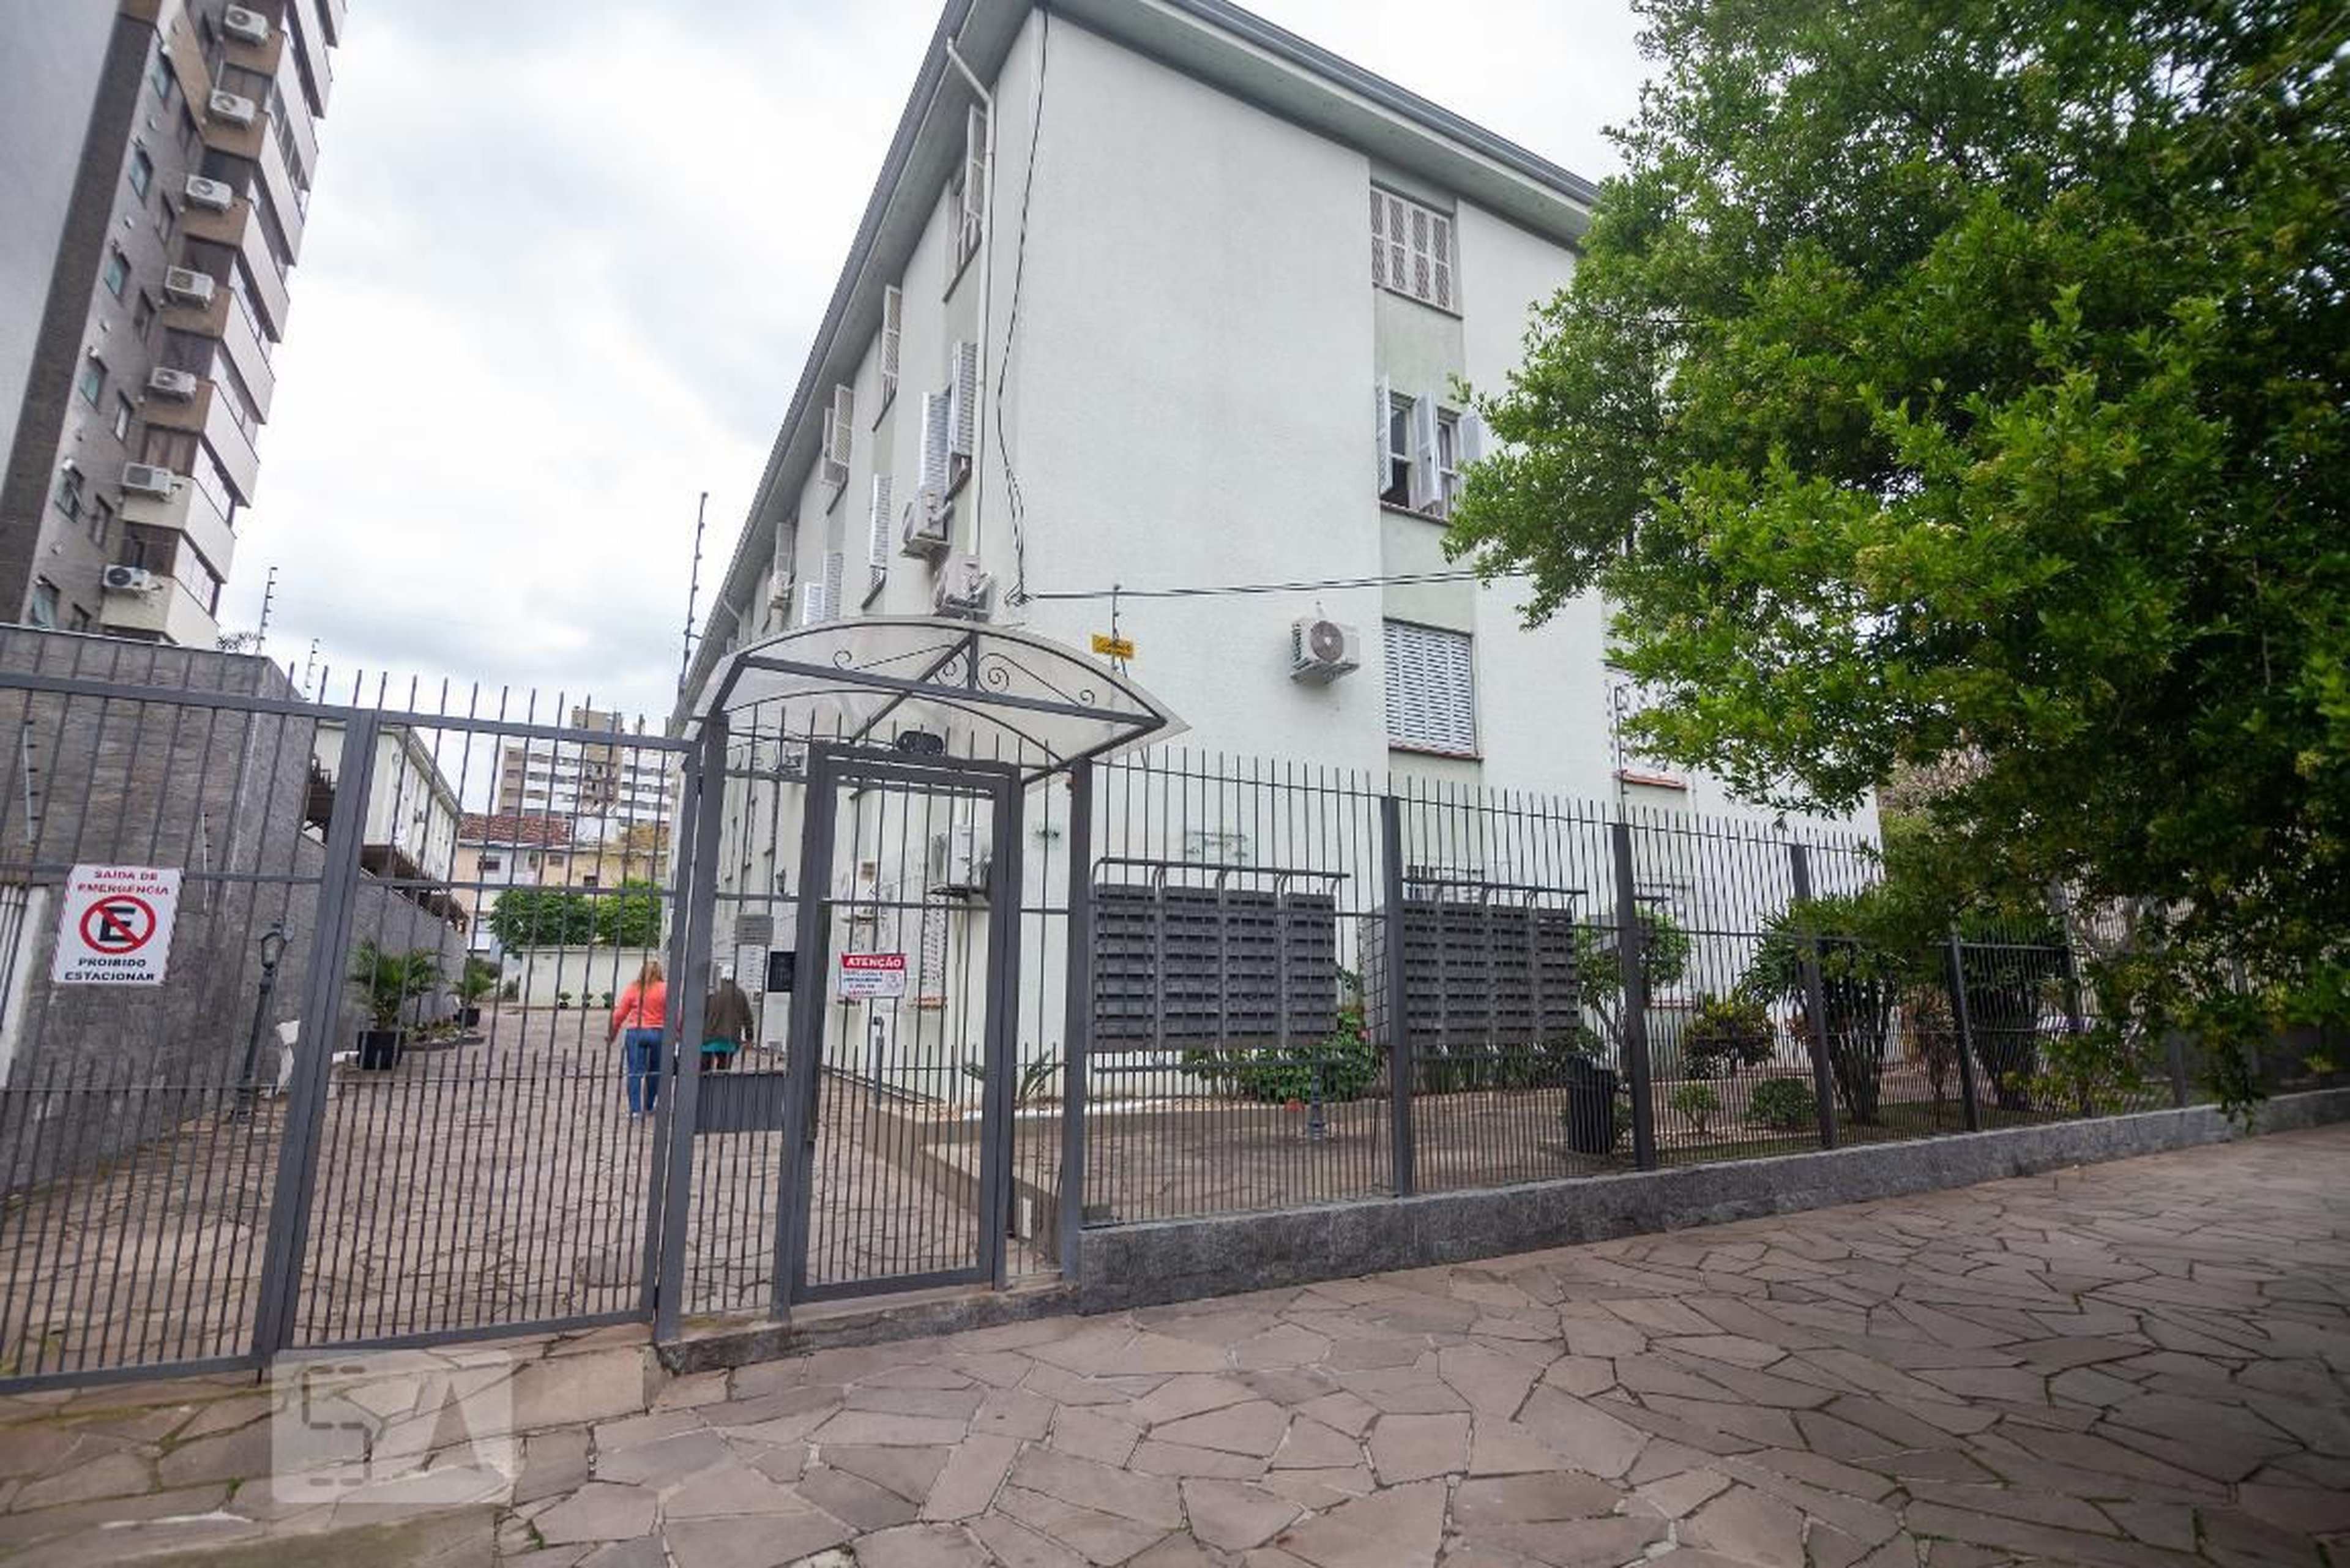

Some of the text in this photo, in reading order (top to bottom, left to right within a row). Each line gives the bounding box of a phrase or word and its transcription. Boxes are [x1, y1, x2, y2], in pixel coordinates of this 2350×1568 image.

[140, 872, 158, 881] DE
[78, 957, 146, 967] PROIBIDO
[846, 957, 901, 968] ATENÇÃO
[65, 971, 154, 980] ESTACIONAR
